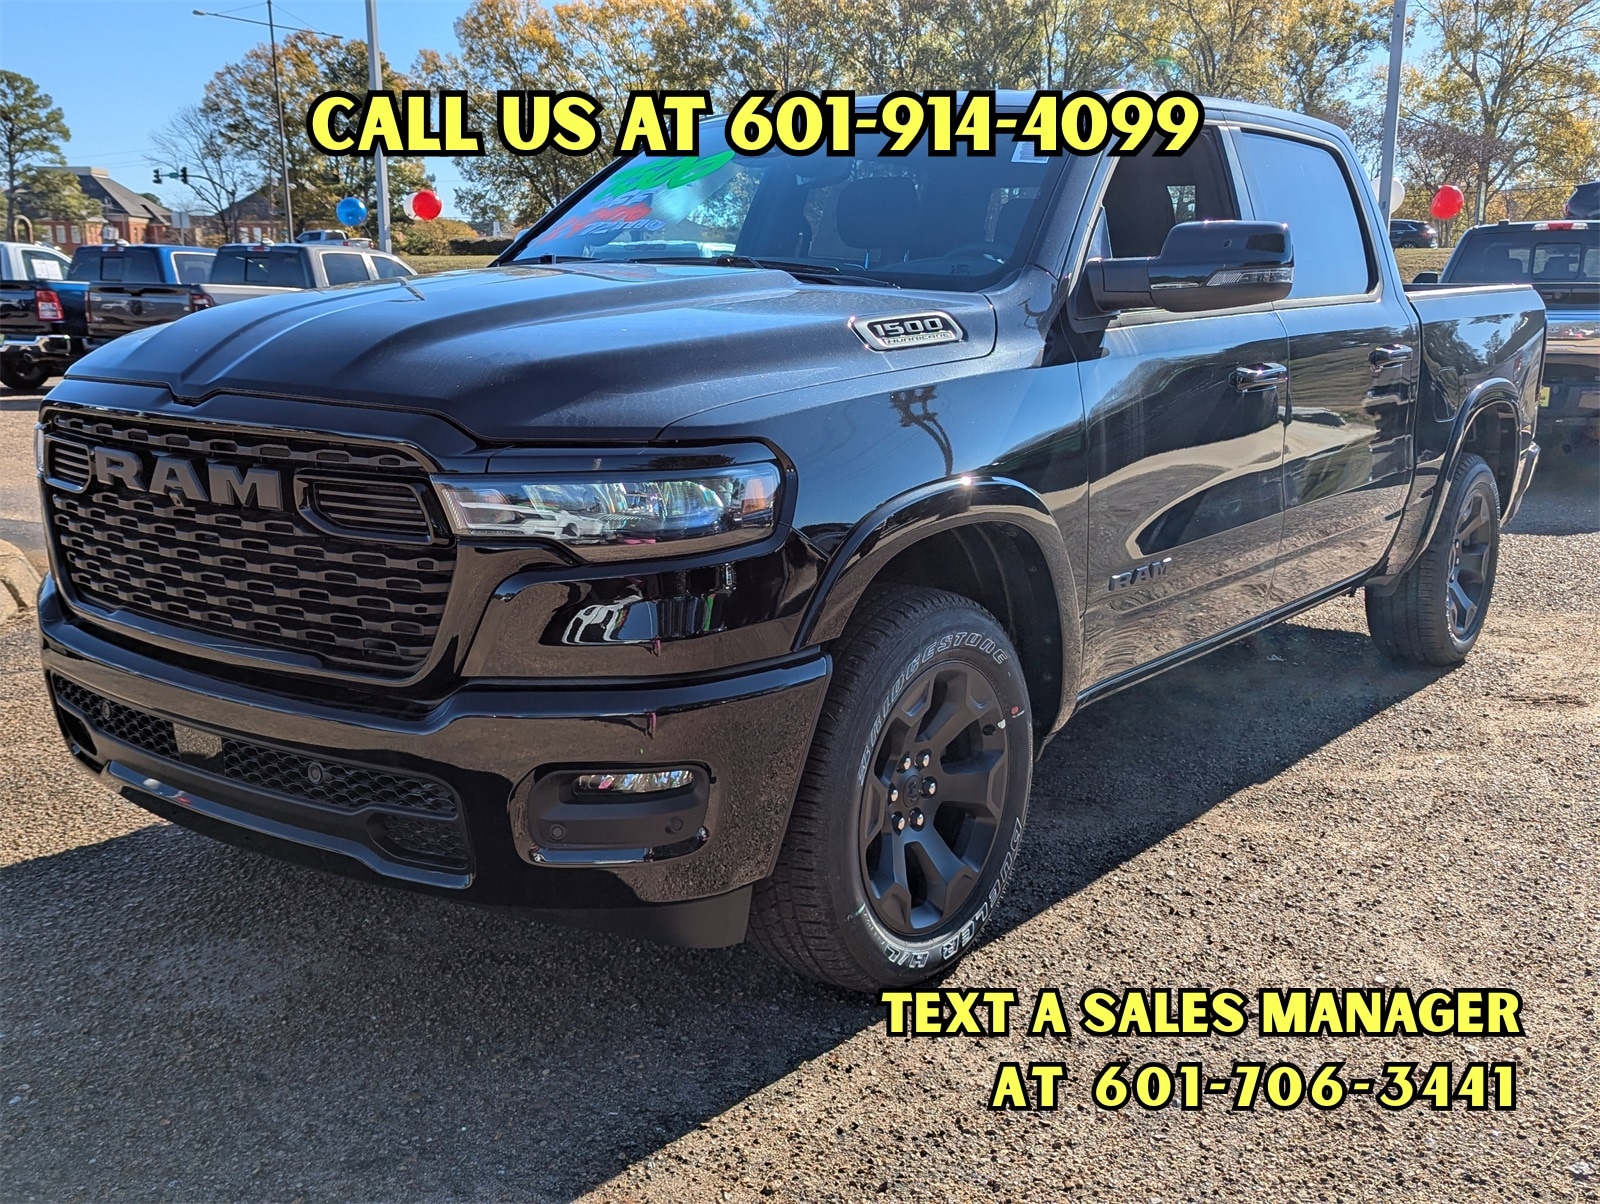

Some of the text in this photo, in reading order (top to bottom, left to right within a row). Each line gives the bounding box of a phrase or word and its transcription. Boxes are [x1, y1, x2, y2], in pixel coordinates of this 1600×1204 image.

[873, 317, 944, 337] 1500
[93, 445, 284, 510] RAM
[857, 631, 1009, 788] BRIDGESTONE
